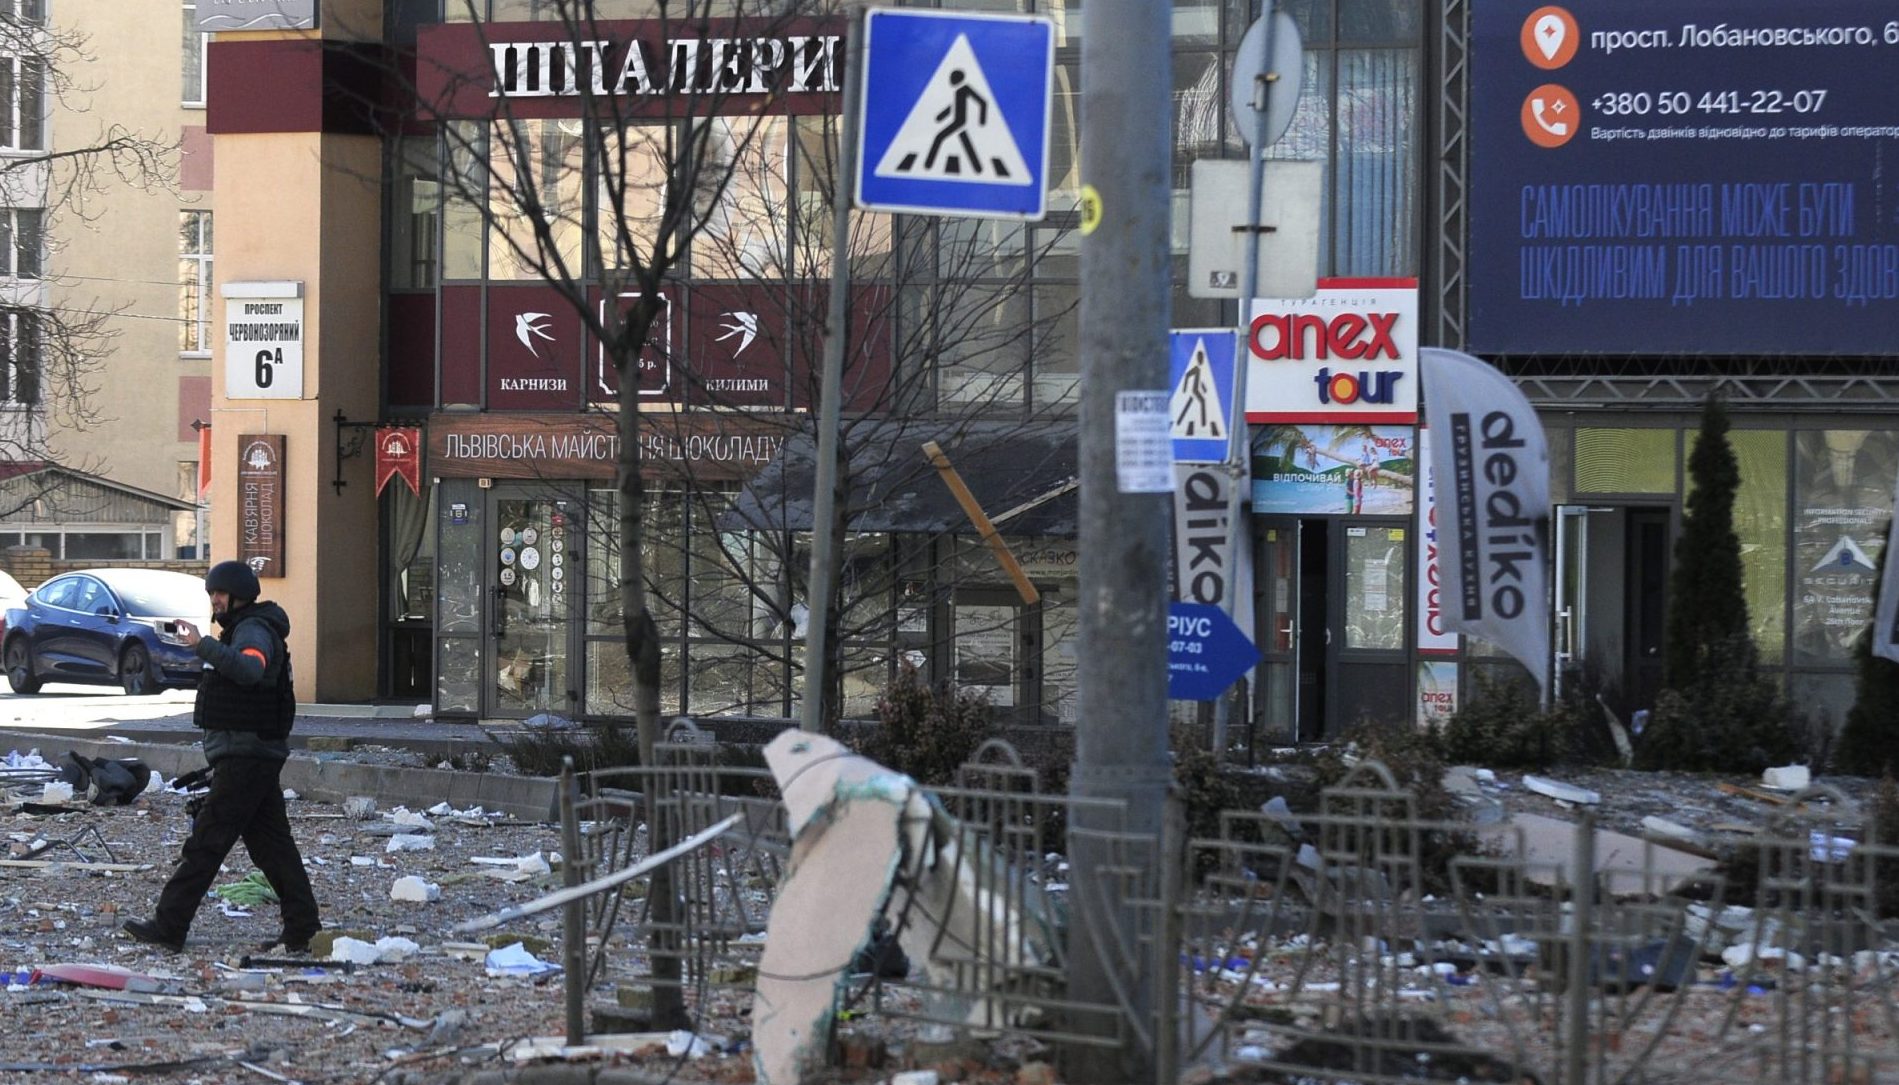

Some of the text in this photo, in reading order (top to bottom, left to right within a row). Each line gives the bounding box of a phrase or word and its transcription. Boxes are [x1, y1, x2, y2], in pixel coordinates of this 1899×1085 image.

[1591, 30, 1673, 55] просп.
[1678, 23, 1878, 48] Лобановського,
[488, 36, 840, 97] ШПАЛЕРИ
[1592, 89, 1828, 115] +380 50 441-22-07
[1591, 126, 1646, 141] Вартість
[1647, 126, 1697, 141] дзвінків
[1768, 127, 1785, 140] до
[1787, 124, 1838, 141] тарифів
[1521, 183, 1713, 238] САМОЛІКУВАННЯ
[1721, 183, 1792, 237] МОЖЕ
[1799, 183, 1856, 237] БУТИ
[1520, 245, 1666, 307] ШКІДЛИВИМ
[1671, 245, 1723, 307] ДЛЯ
[1731, 245, 1827, 300] ВАШОГО
[245, 304, 283, 314] ПРОСПЕКТ
[229, 320, 299, 341] ЧЕРВОНОЗОРЯНИЙ
[1248, 313, 1402, 361] anex
[500, 378, 568, 392] КАРНИЗИ
[706, 378, 769, 392] КИЛИМИ
[1314, 367, 1404, 405] tour
[445, 430, 785, 465] ЛЬВІВСЬКА МАЙСТНЯ ШОКОЛАДУ
[1375, 437, 1406, 449] anex
[1273, 473, 1341, 483] ВІДПОЧИВАЙ
[261, 483, 275, 545] ШОКОЛАД
[1464, 549, 1476, 607] КУХНЯ
[1166, 615, 1212, 637] РІУС
[1423, 692, 1453, 703] anex
